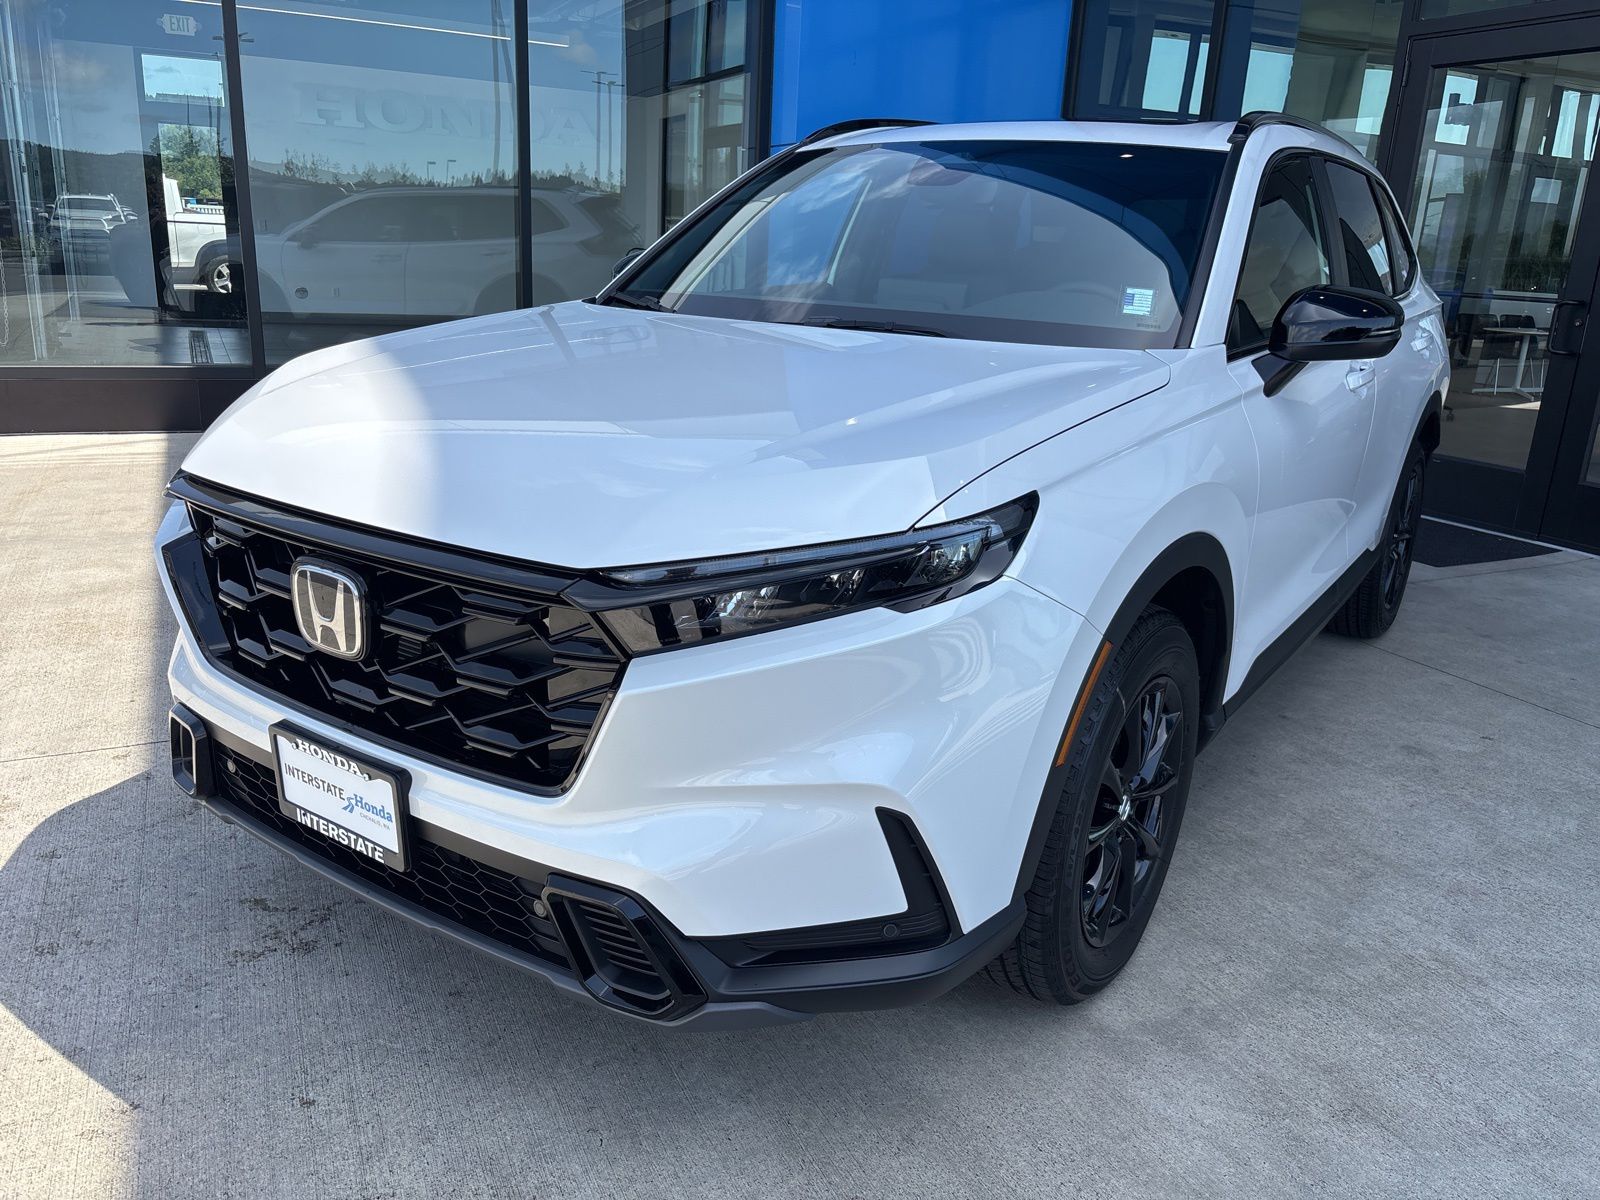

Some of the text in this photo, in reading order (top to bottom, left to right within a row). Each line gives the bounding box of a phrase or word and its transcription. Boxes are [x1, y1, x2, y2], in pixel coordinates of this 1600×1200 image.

[168, 15, 190, 33] EXIT
[294, 83, 601, 145] HONDA
[296, 738, 363, 777] HONDA
[284, 762, 394, 823] INTERSTATE Honda
[296, 807, 385, 864] INTERSTATE
